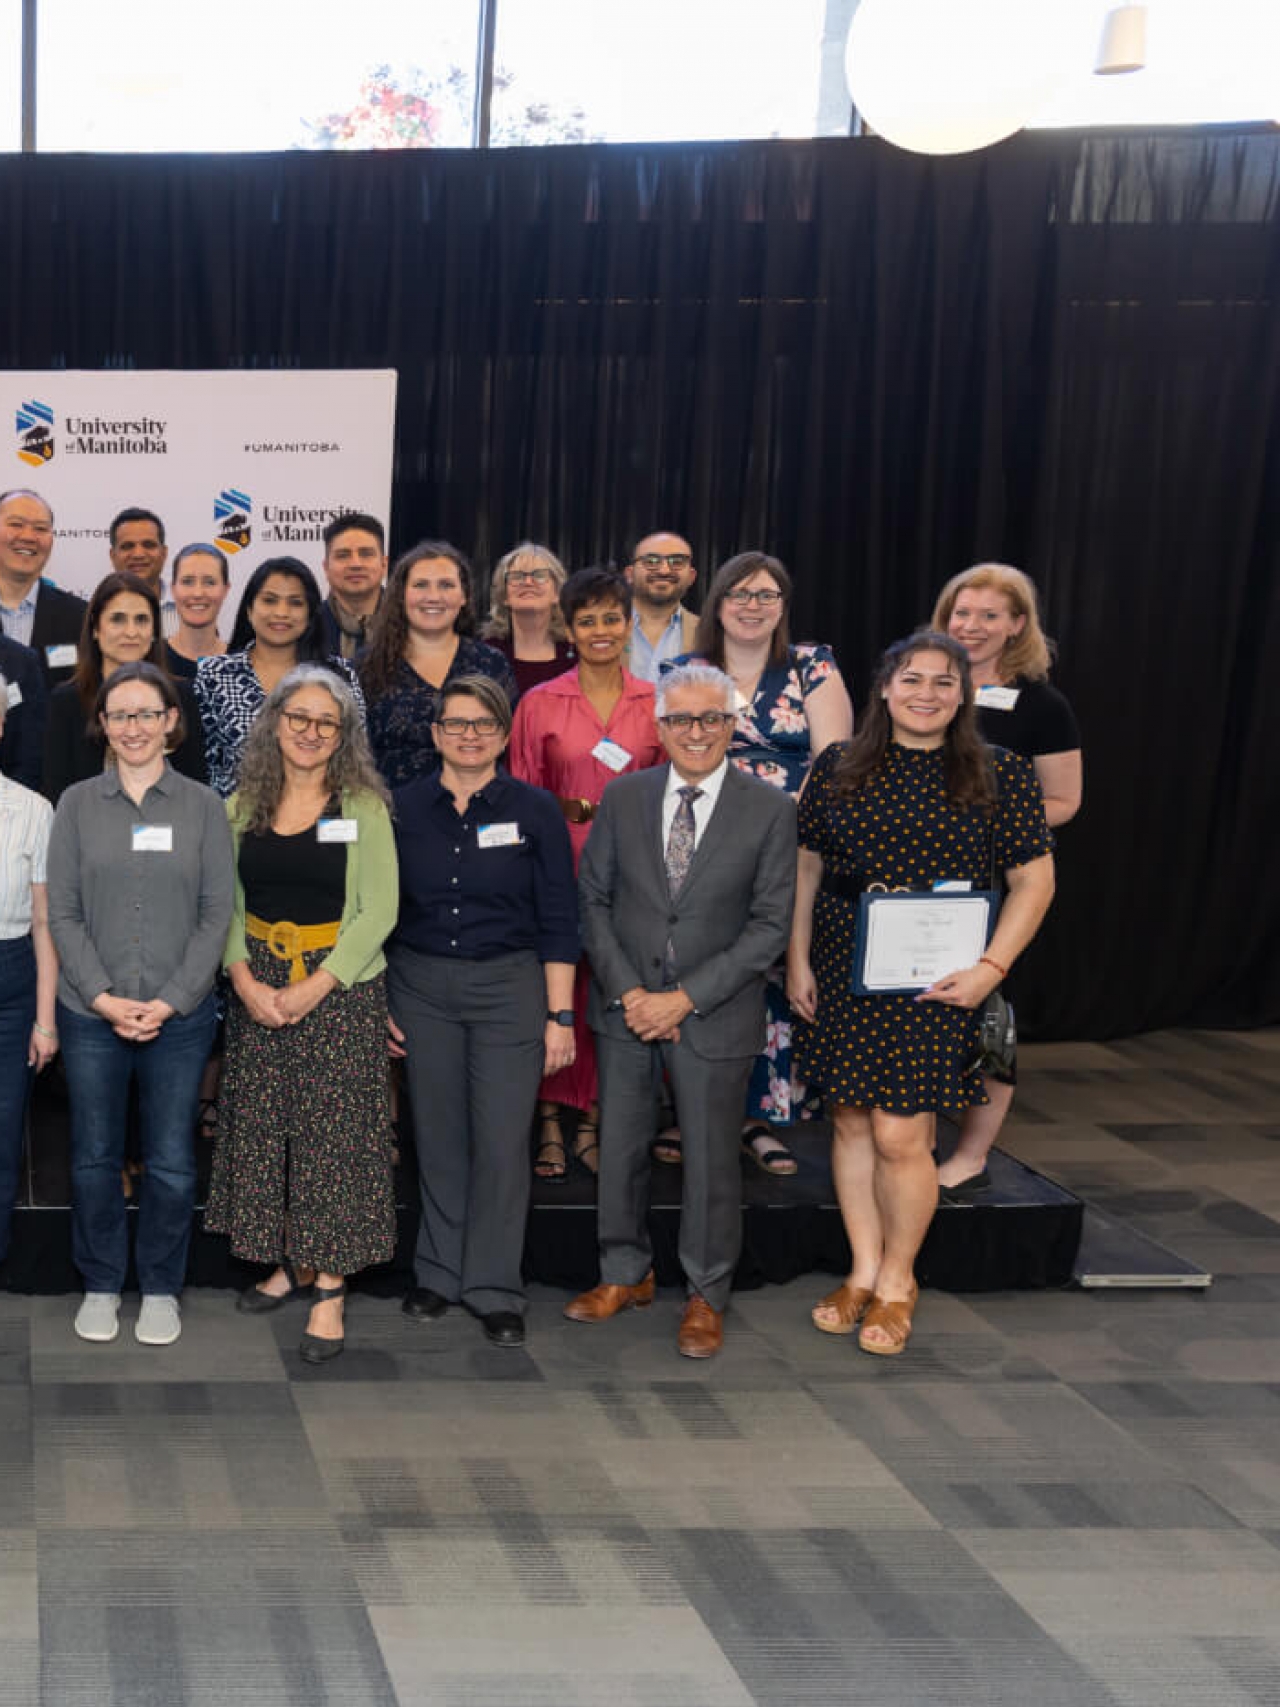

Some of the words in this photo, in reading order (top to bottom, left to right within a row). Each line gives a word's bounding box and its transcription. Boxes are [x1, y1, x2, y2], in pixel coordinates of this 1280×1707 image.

[66, 417, 168, 438] University
[77, 436, 168, 454] Manitoba
[274, 524, 324, 542] Mani
